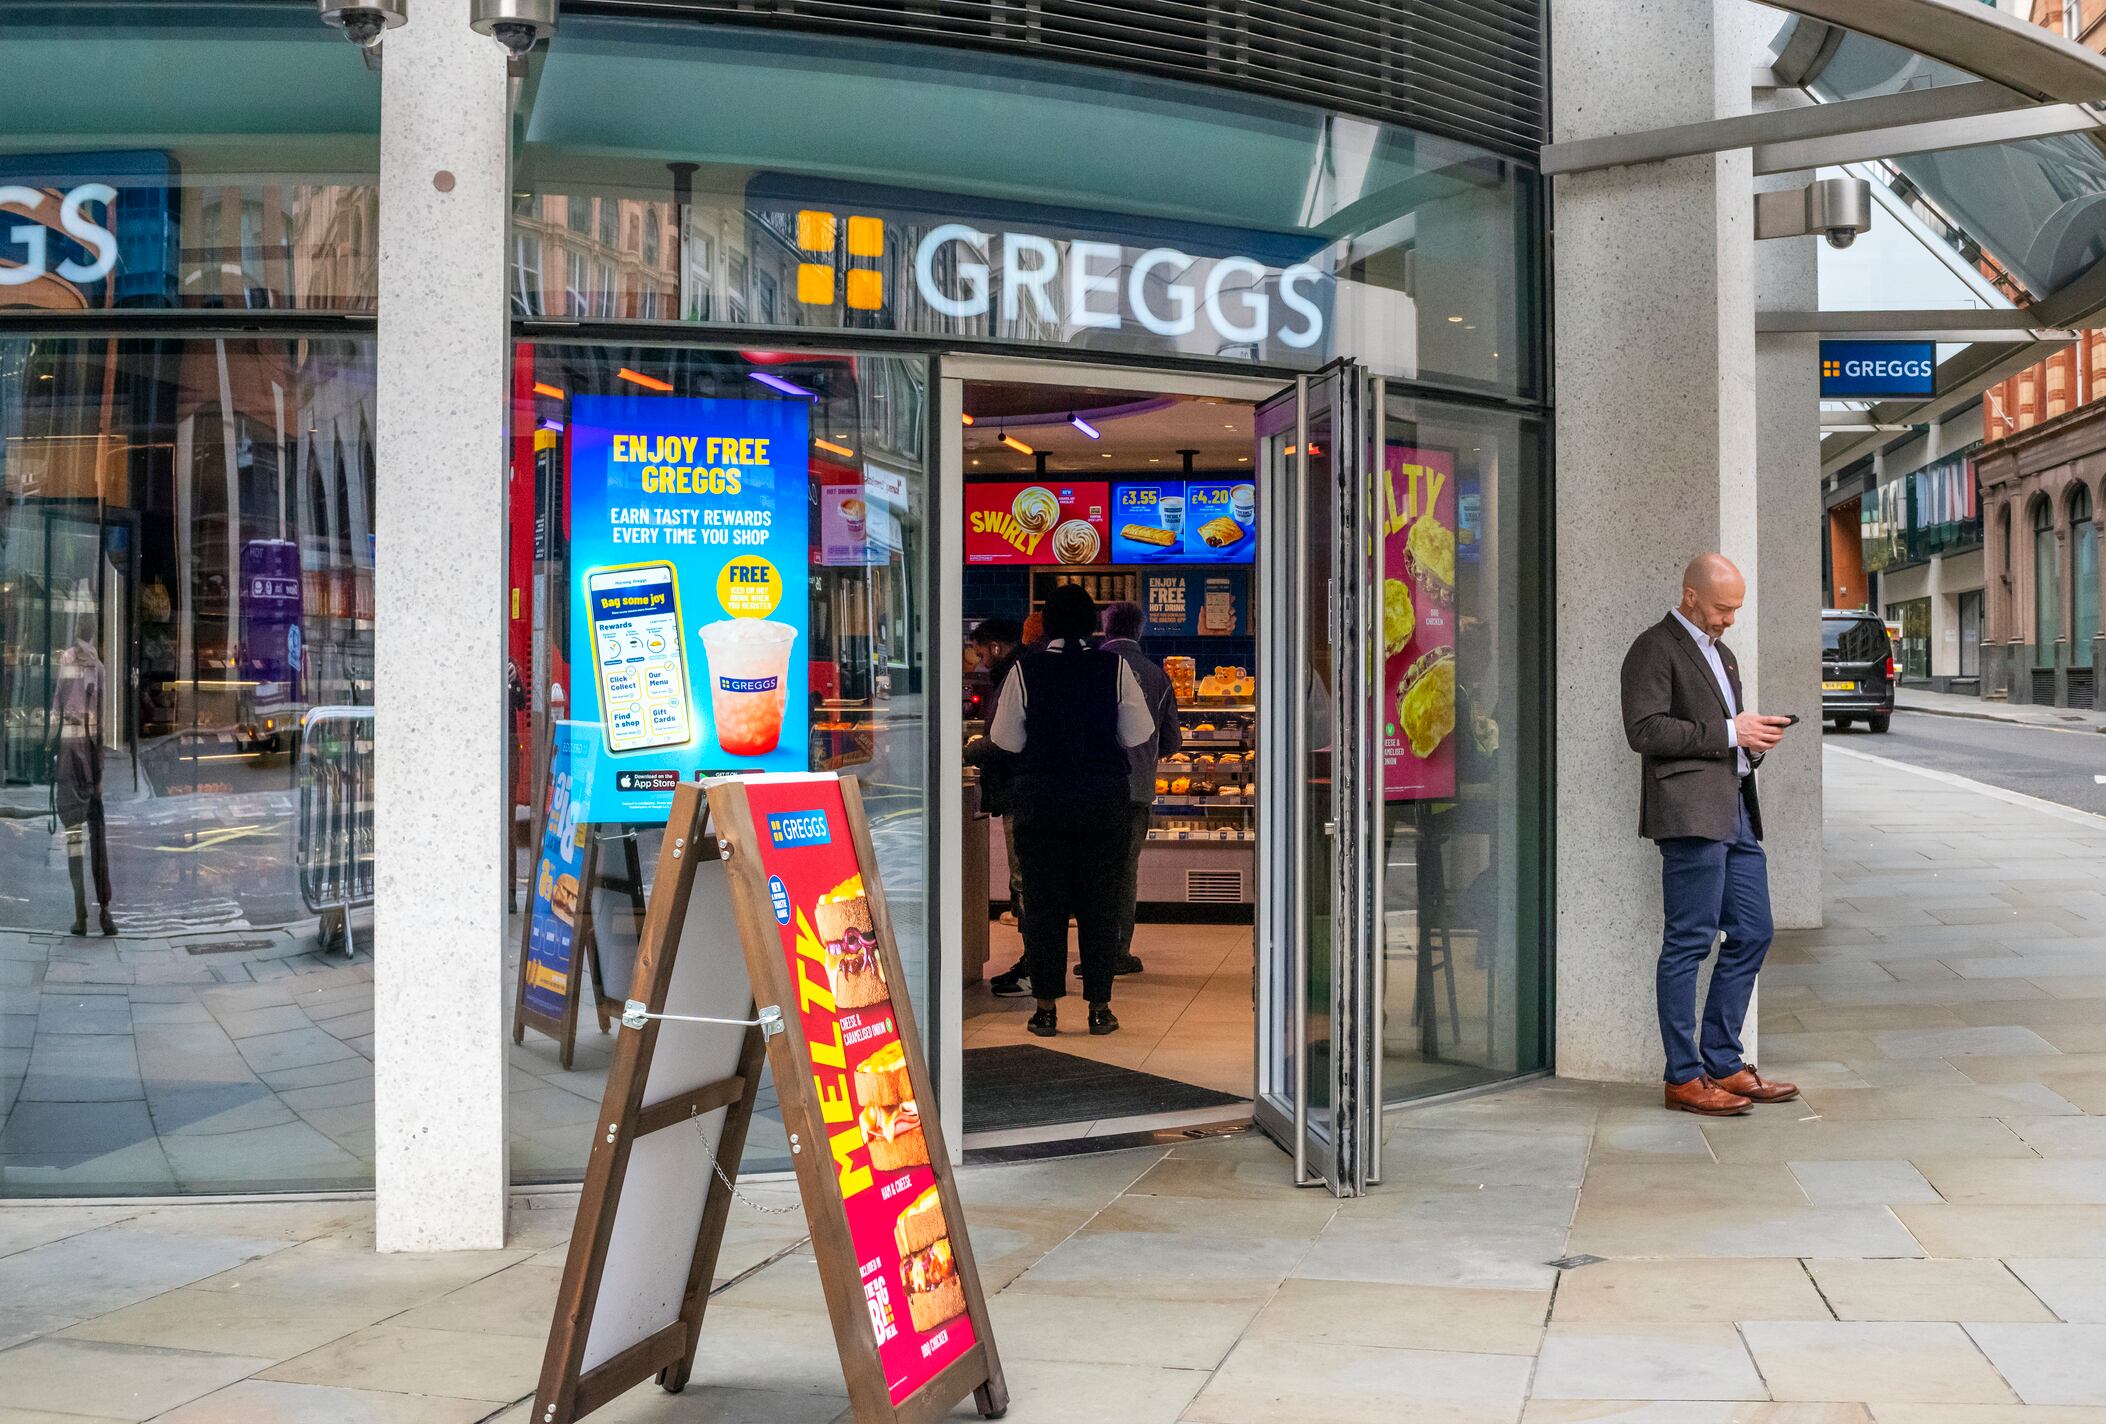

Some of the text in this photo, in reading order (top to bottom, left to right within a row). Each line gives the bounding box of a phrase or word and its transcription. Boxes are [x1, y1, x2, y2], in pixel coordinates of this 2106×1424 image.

[915, 224, 1323, 348] GREGGS
[1845, 360, 1931, 377] GREGGS
[613, 435, 770, 465] ENJOY FREE
[642, 466, 741, 495] GREGGS
[1122, 490, 1157, 505] £3.55
[1192, 490, 1229, 504] £4.20
[1368, 463, 1446, 545] LTY
[611, 508, 771, 526] EARN TASTY REWARDS
[613, 528, 769, 545] EVERY TIME YOU SHOP
[970, 511, 1045, 556] SWIRLY
[730, 566, 769, 582] FREE
[1150, 577, 1185, 587] ENJOY A
[601, 593, 665, 608] Bag some joy
[1150, 588, 1185, 603] FREE
[1150, 604, 1185, 612] HOT DRINK
[599, 622, 632, 630] Rewards
[611, 683, 636, 691] Collect
[732, 679, 775, 690] GREGGS
[622, 720, 640, 728] shop
[1385, 738, 1396, 747] EESE
[634, 779, 675, 788] App Store
[783, 816, 827, 840] GREGGS
[840, 1013, 862, 1031] CHEESE &
[843, 1021, 887, 1047] CARAMELISED ONION
[796, 905, 874, 1199] MELTY
[881, 1174, 912, 1200] HAM & CHEESE
[860, 1258, 878, 1279] NCLUDED
[867, 1275, 889, 1347] BIG
[921, 1329, 949, 1359] BBQ CHICKEN
